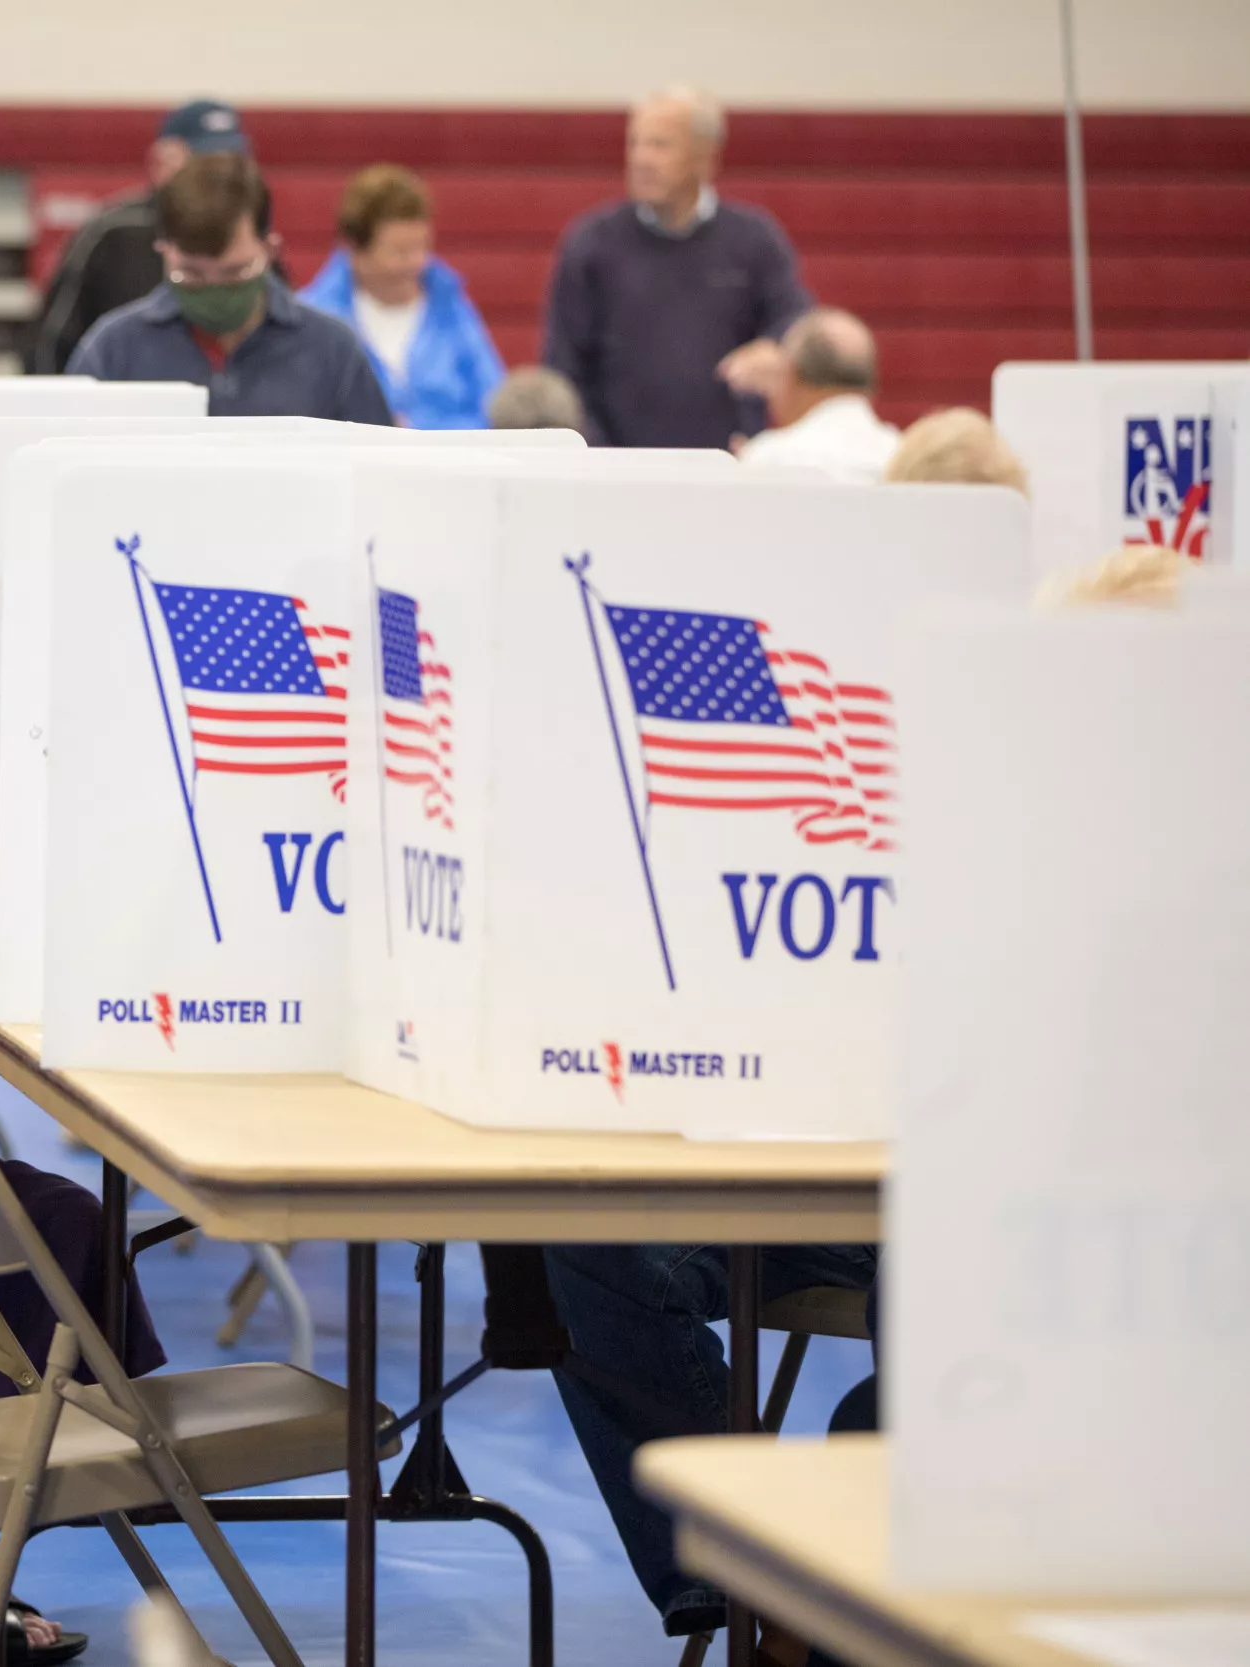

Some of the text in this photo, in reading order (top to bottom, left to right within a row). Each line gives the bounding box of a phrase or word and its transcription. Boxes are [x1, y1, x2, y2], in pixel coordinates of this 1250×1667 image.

[403, 845, 463, 943] VOTE
[721, 872, 898, 961] VOT
[98, 999, 302, 1024] POLL MASTER II
[541, 1049, 761, 1078] POLL MASTER II
